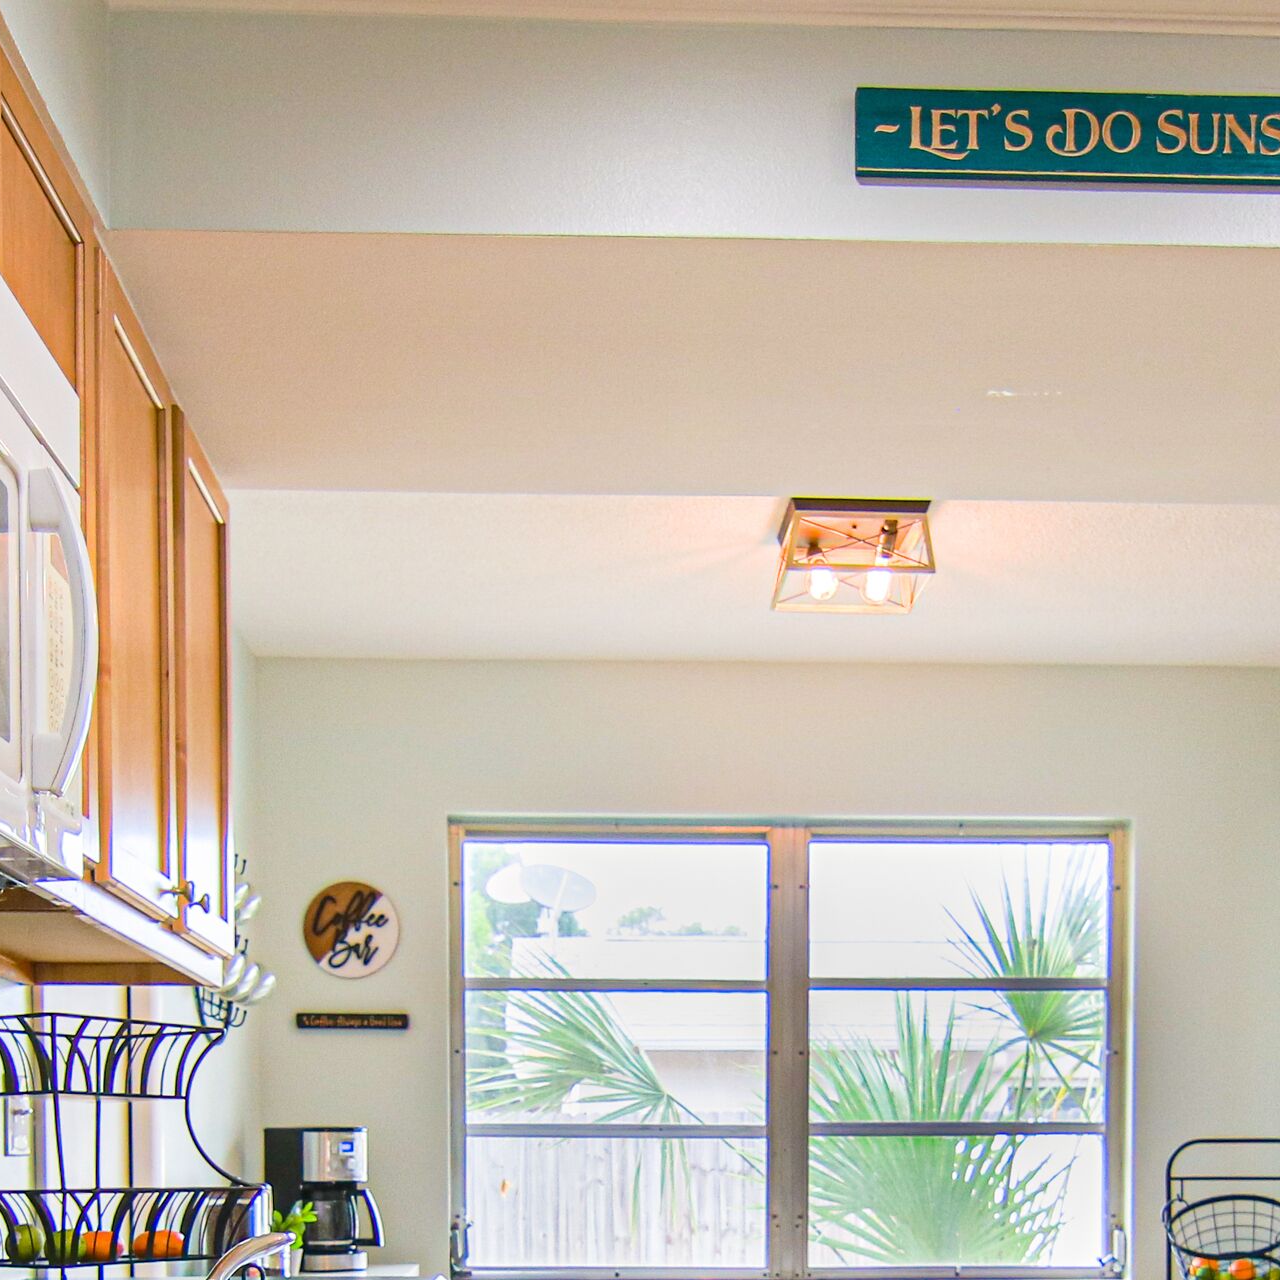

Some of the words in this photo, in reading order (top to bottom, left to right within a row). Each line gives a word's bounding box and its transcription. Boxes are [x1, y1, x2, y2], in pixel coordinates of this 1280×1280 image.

[1045, 107, 1142, 155] DO
[312, 890, 389, 938] Coffee
[328, 931, 379, 969] Bar
